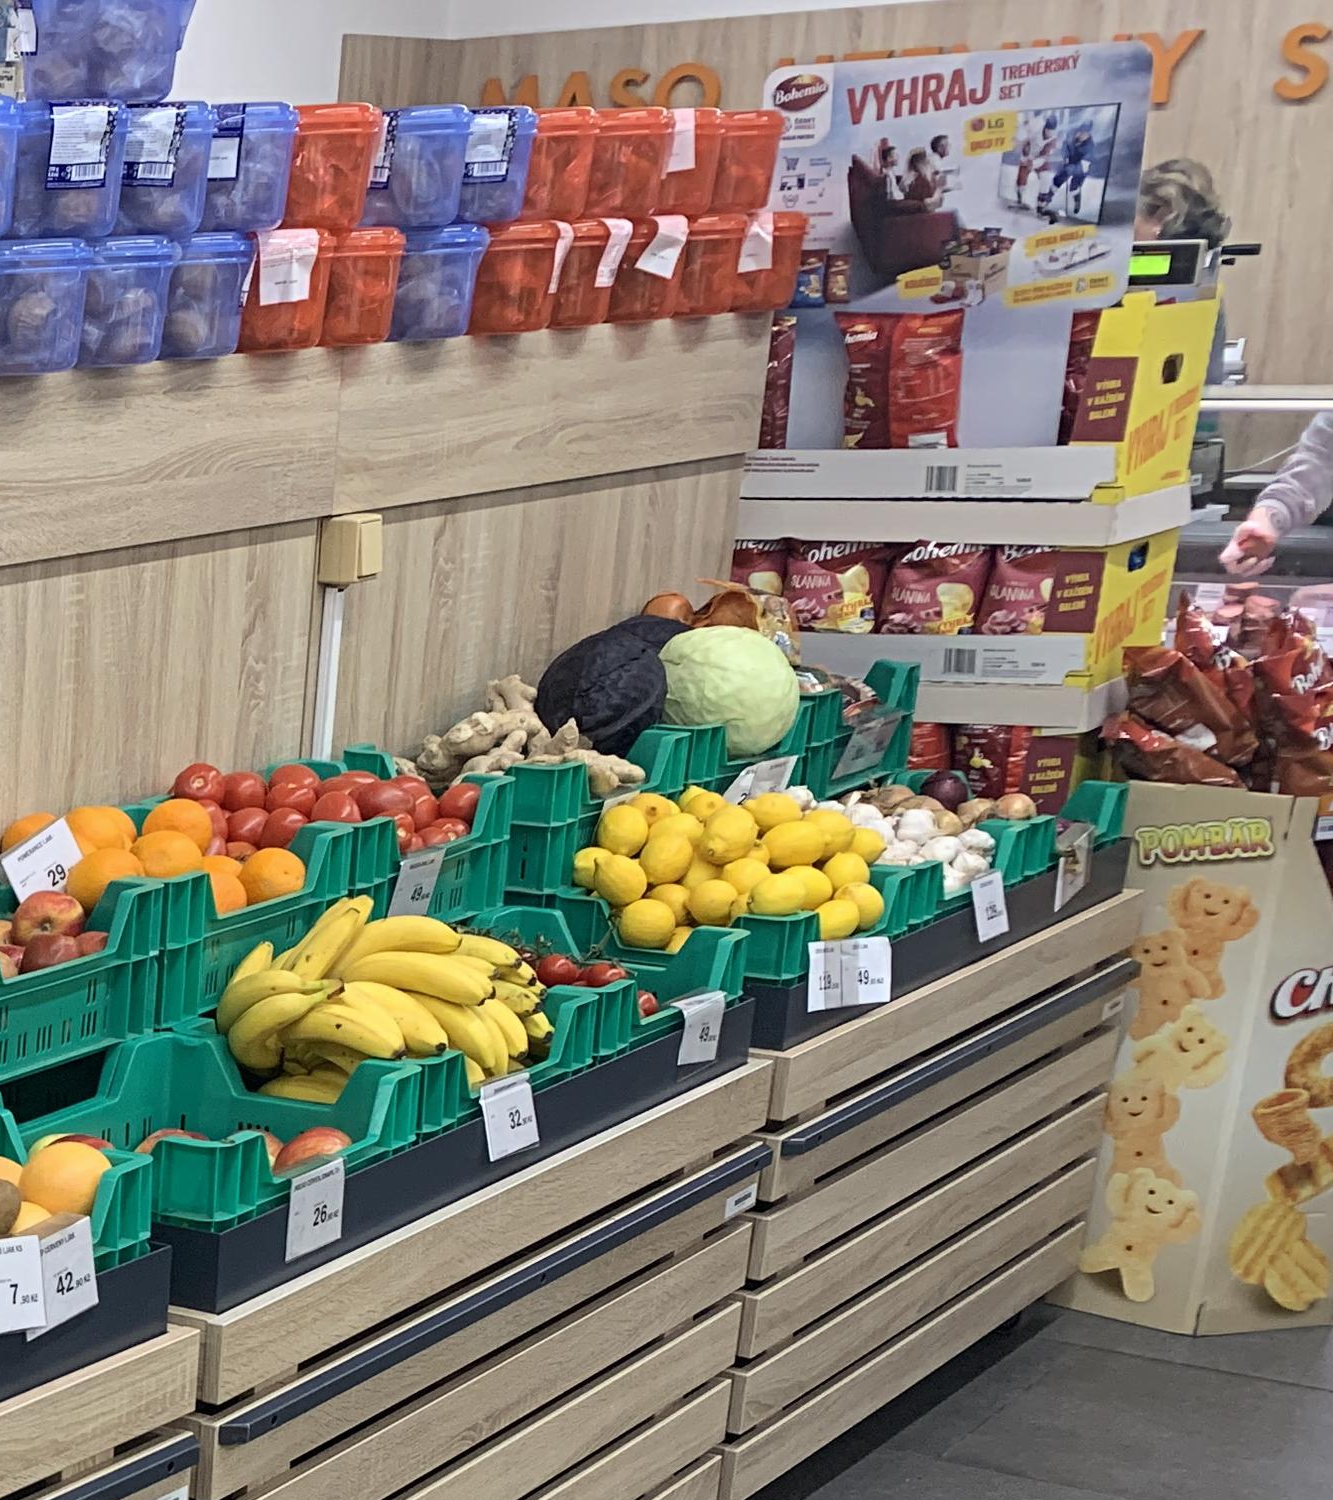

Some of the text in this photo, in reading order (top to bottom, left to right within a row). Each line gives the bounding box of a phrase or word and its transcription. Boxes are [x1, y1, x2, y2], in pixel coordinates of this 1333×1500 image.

[480, 62, 722, 109] MASO
[774, 82, 829, 105] Bohemia
[847, 63, 993, 125] VYHRAJ
[1001, 50, 1081, 81] TRENÉRSKÝ
[999, 83, 1024, 100] SET
[988, 118, 1004, 129] LG
[844, 330, 878, 344] hemia
[790, 573, 831, 590] SLANINA
[47, 864, 66, 887] 29
[10, 1283, 30, 1304] 7,90
[56, 1272, 83, 1296] 42,90
